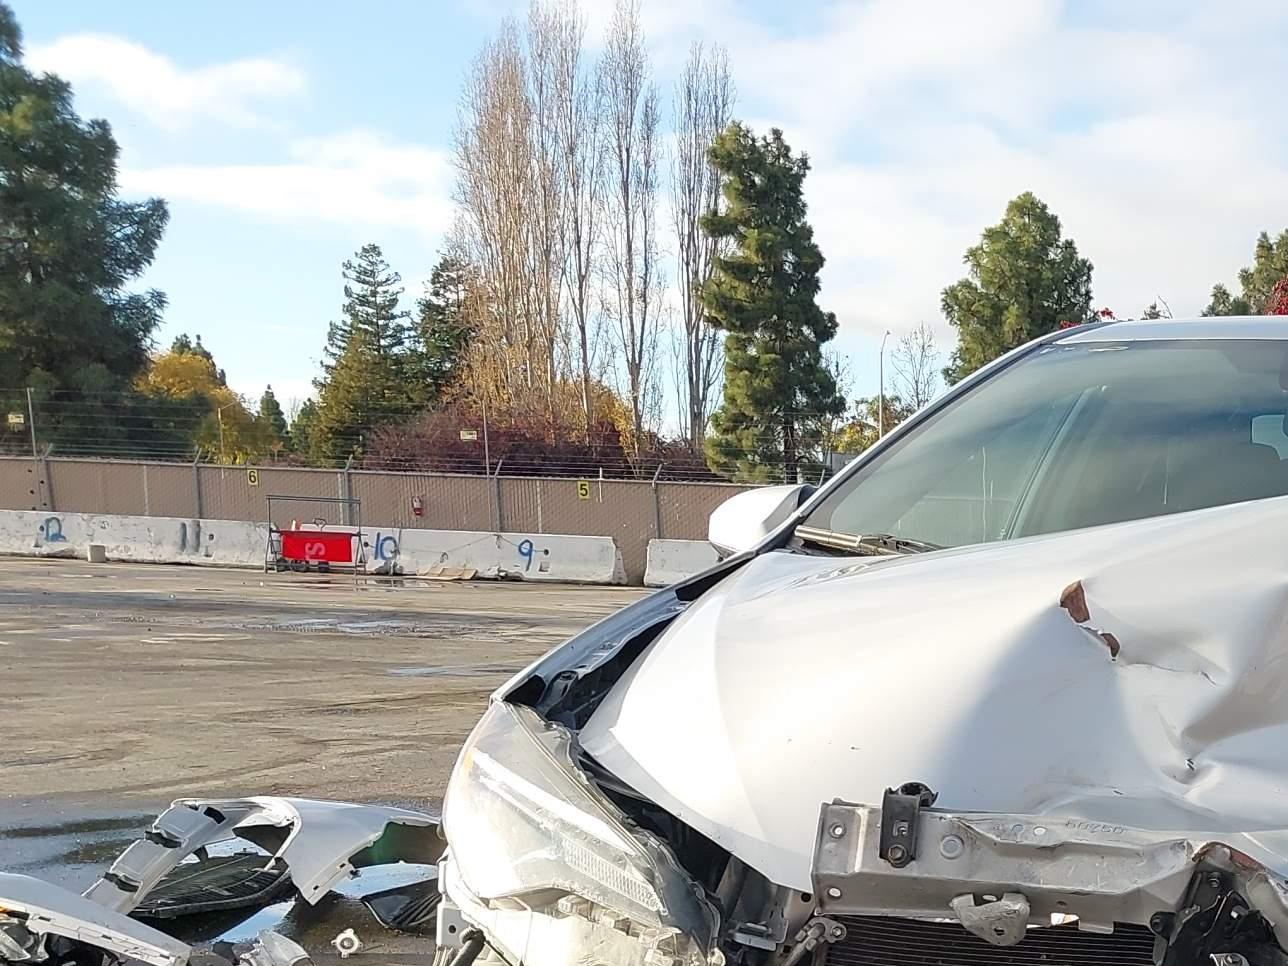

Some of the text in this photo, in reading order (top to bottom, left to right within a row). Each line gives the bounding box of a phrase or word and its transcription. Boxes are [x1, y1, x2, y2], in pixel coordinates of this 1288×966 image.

[248, 470, 257, 484] 6
[579, 483, 588, 498] 5
[374, 532, 399, 560] 10
[518, 540, 534, 570] 9
